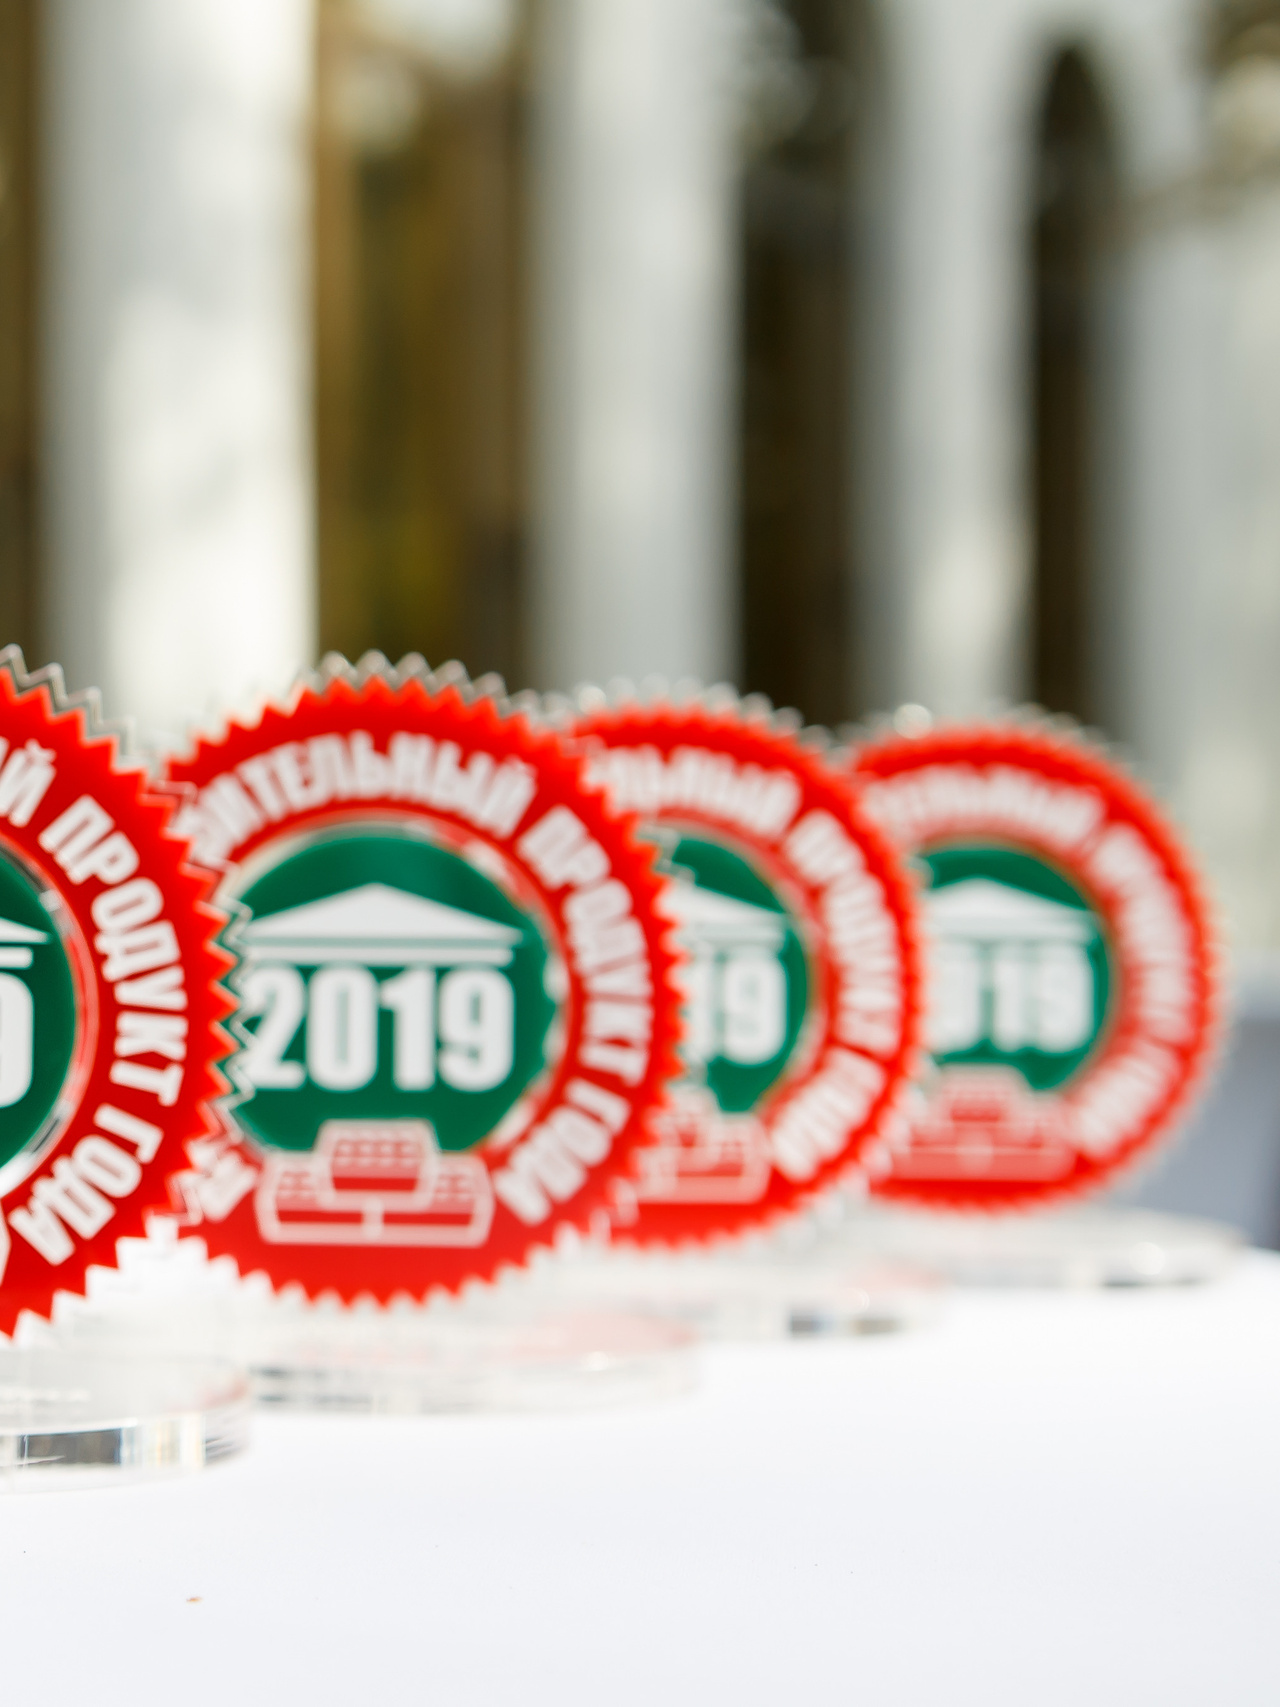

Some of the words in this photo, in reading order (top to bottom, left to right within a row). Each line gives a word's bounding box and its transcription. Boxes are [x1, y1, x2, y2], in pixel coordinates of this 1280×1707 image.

[39, 797, 188, 1105] ПРОДУКТ
[242, 965, 514, 1091] 2019
[10, 1105, 163, 1265] ГОДА
